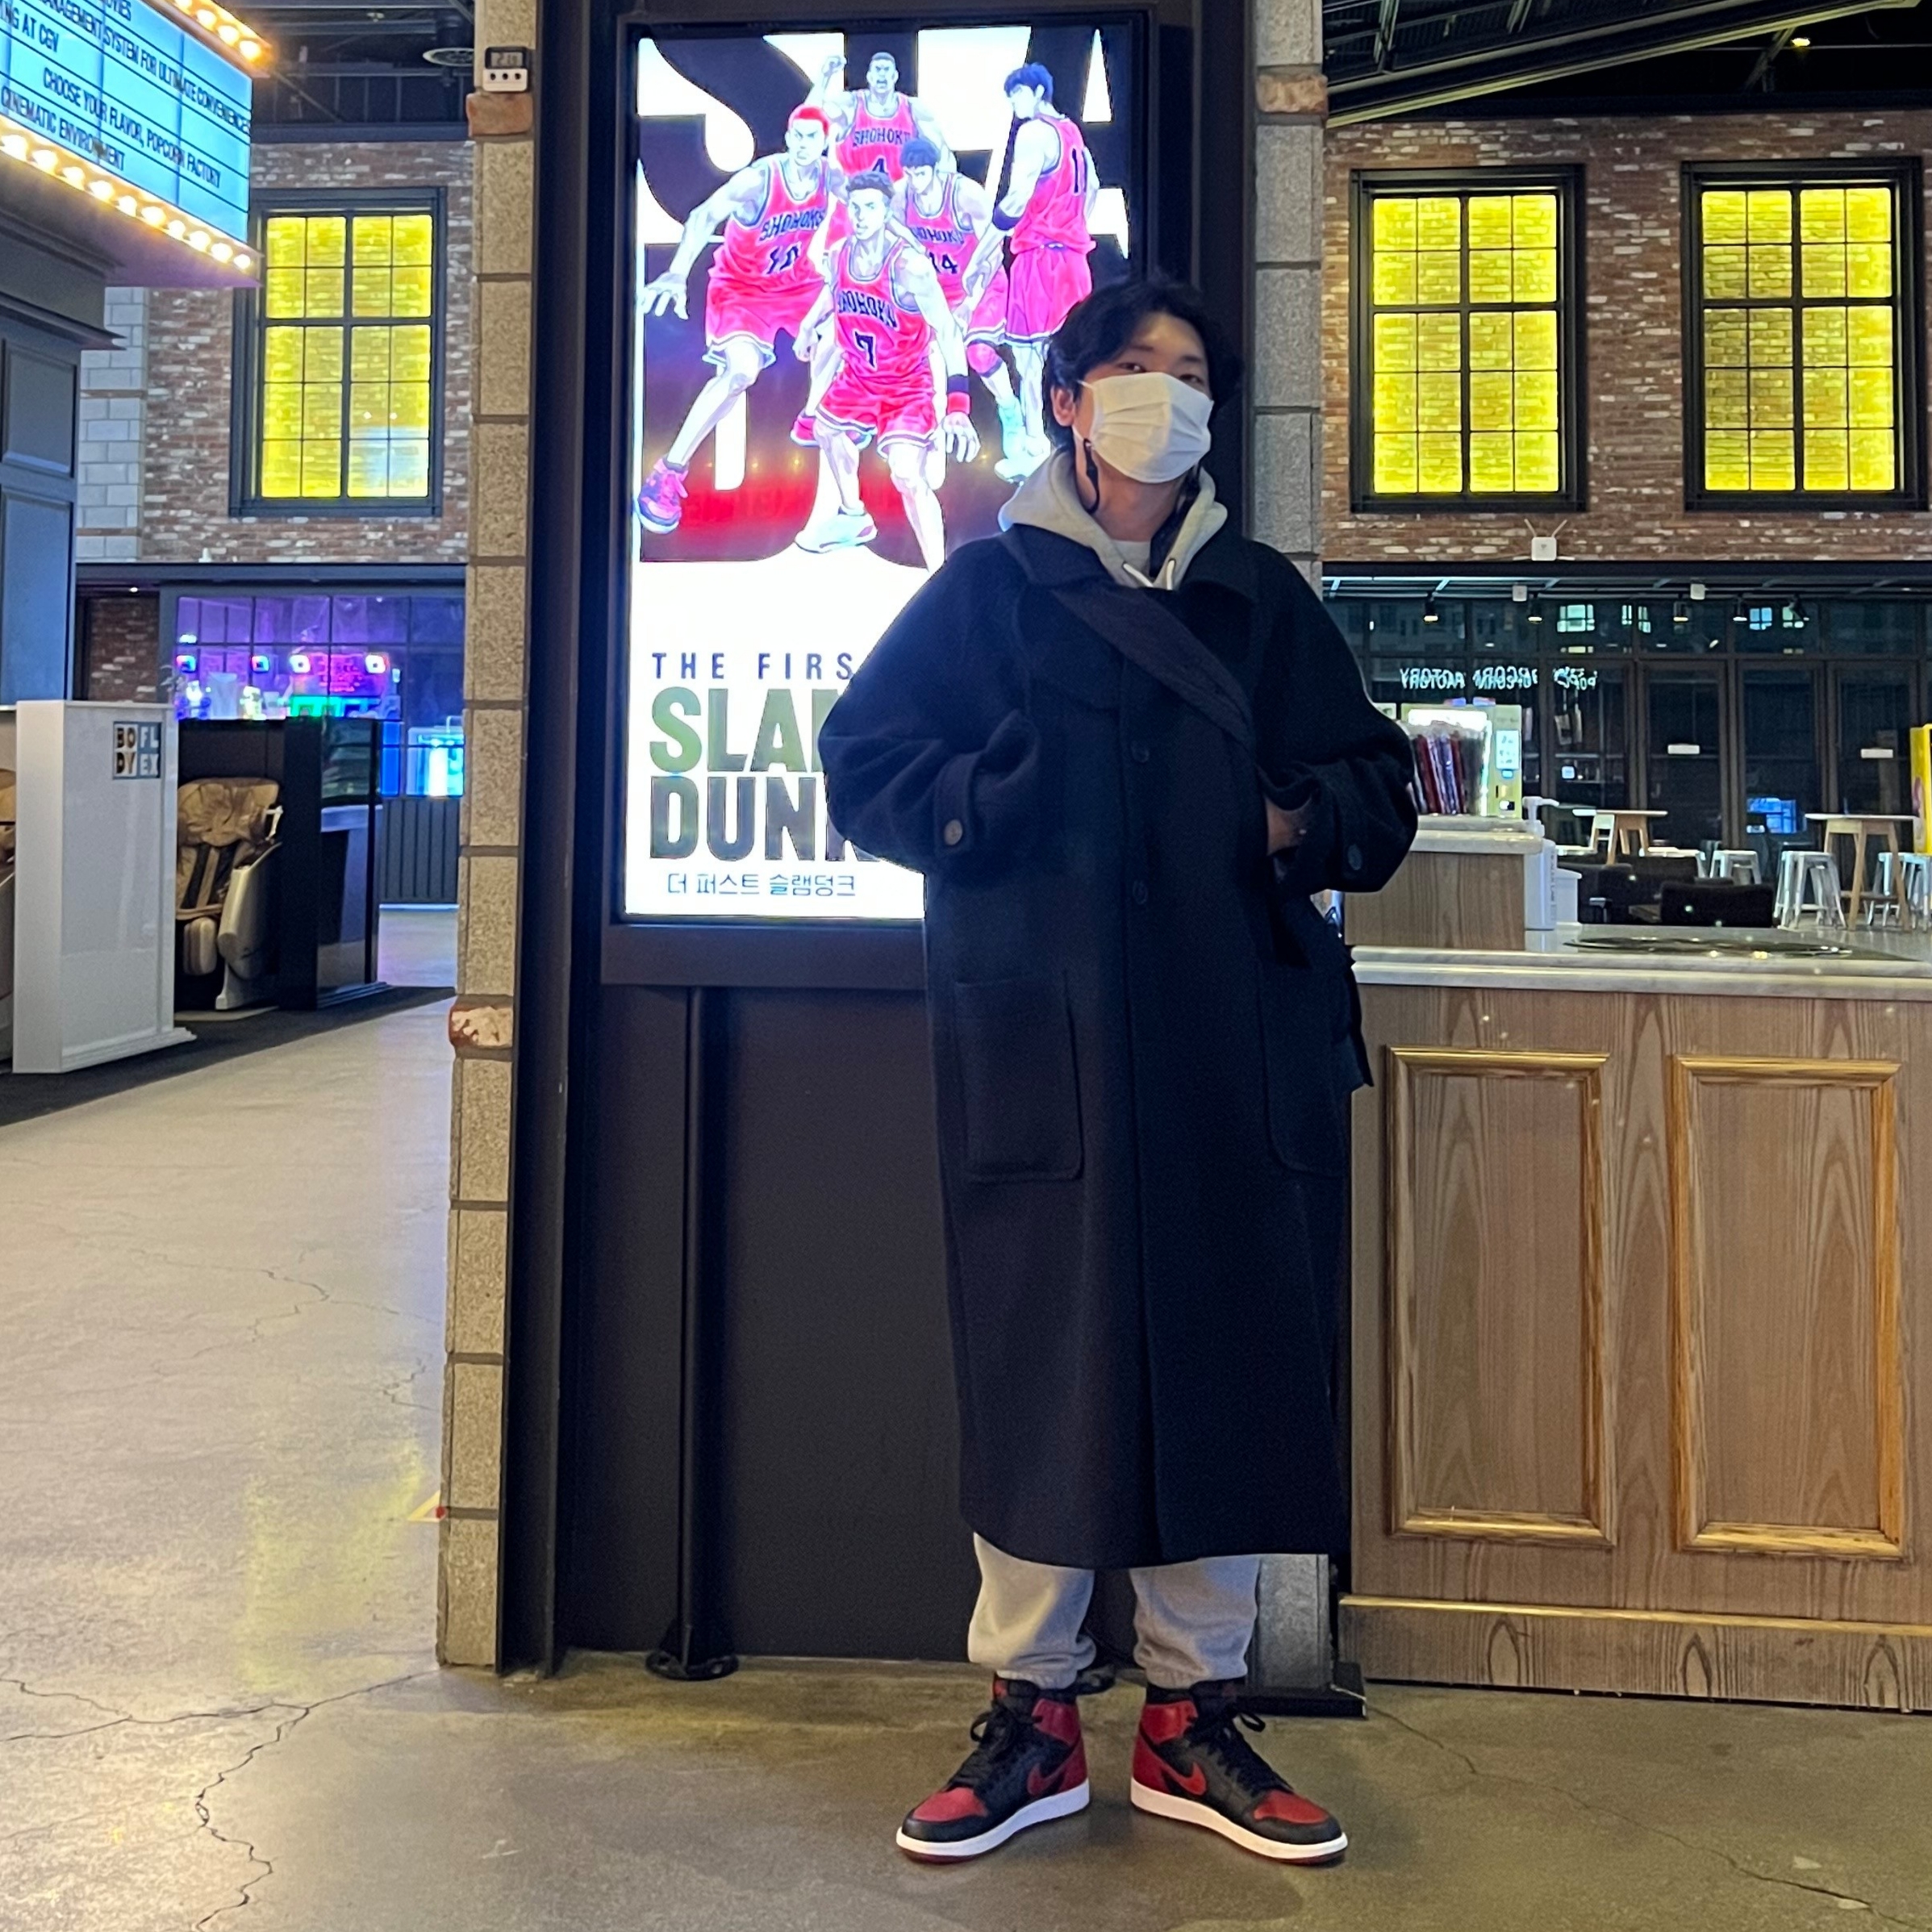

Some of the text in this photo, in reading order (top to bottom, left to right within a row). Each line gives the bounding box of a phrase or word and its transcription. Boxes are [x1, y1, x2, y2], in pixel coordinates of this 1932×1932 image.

[22, 13, 37, 40] AT
[140, 49, 156, 76] FOR
[1, 86, 56, 133] CINEMATIC
[44, 67, 221, 188] CHOOSE YOUR FLAVOR, POPCORN FACTORY
[929, 252, 958, 274] 14
[854, 331, 875, 369] 7
[652, 653, 855, 679] THE FIRS
[668, 874, 856, 896] 더 퍼스트 슬램덩크
